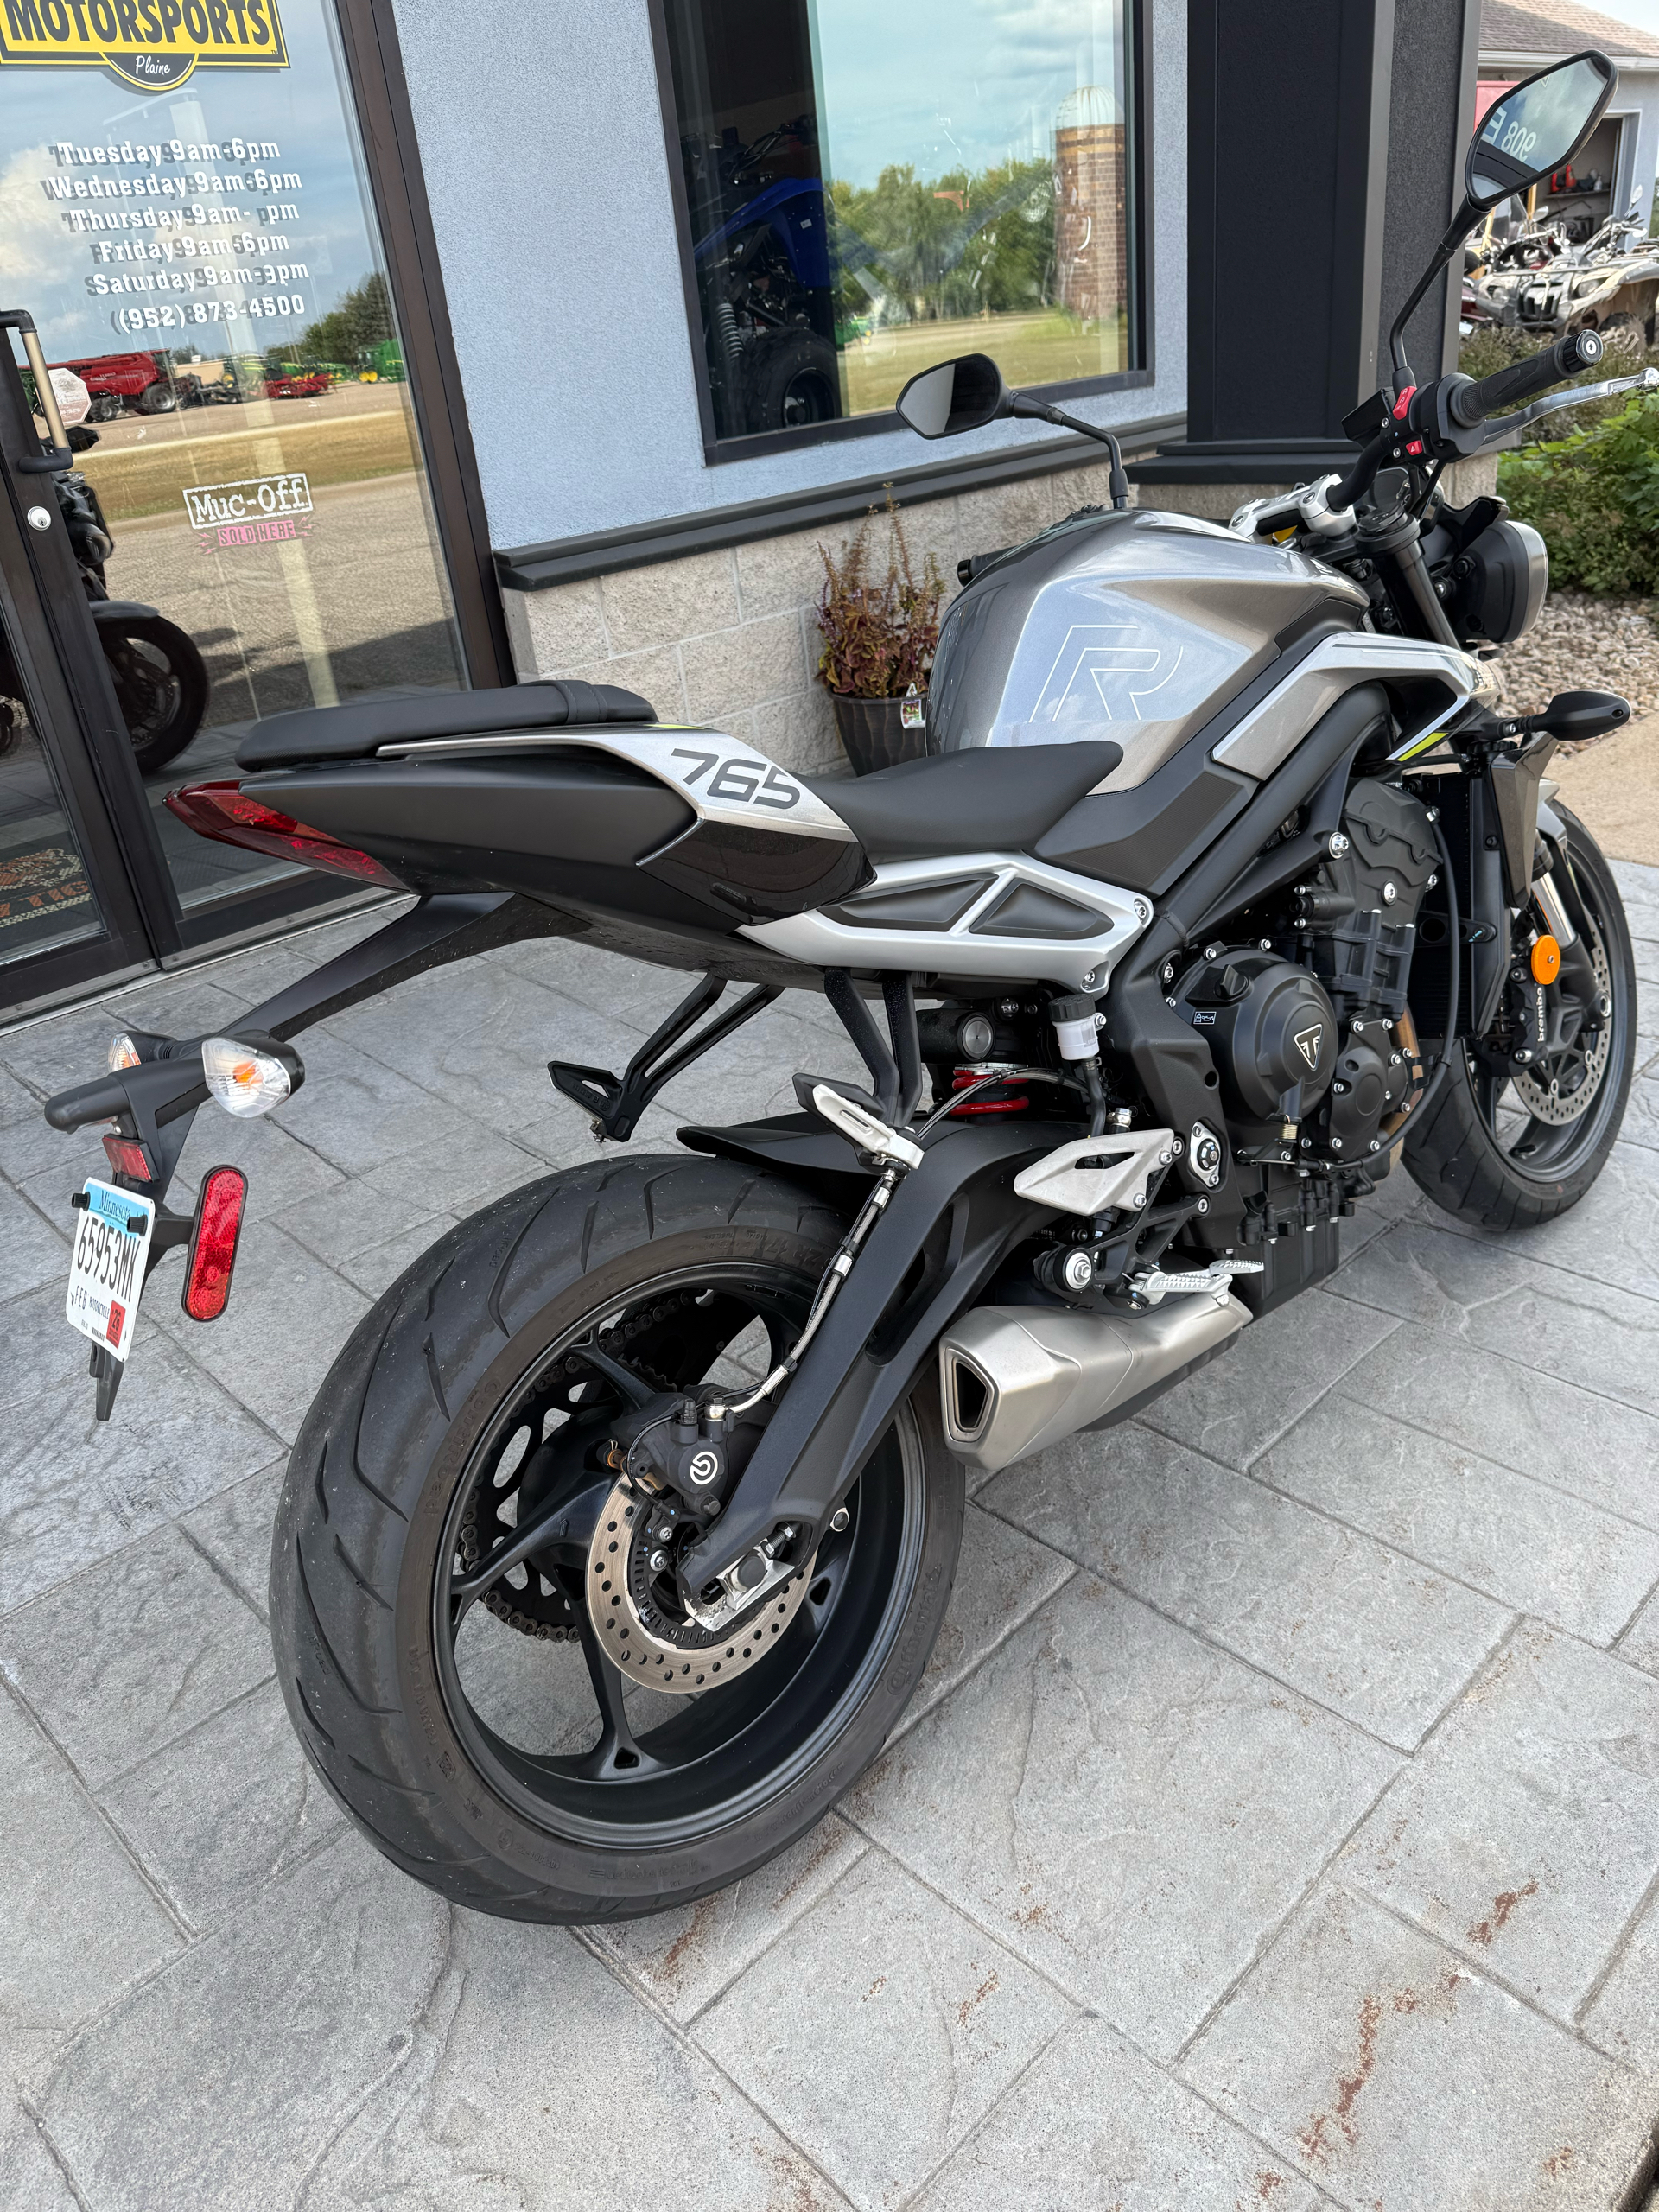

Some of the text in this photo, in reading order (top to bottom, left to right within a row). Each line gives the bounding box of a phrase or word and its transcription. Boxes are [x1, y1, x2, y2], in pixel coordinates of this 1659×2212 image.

[4, 0, 270, 46] MOTORSPORTS
[135, 55, 171, 75] Plaine
[56, 138, 281, 166] Tuesday 9am-6pm
[48, 169, 302, 199] Wednesday 9am-6pm
[69, 205, 184, 232] Thursday
[98, 232, 290, 263] Friday 9am-6pm
[92, 268, 196, 295] Saturday
[118, 294, 305, 334] (952) 873-4500
[191, 478, 305, 523] Muc-Off
[219, 522, 295, 545] SOLD HERE
[671, 747, 801, 810] 765
[1535, 987, 1546, 1042] brembo
[99, 1189, 130, 1222] Minnesota
[77, 1215, 141, 1303] 65953MK
